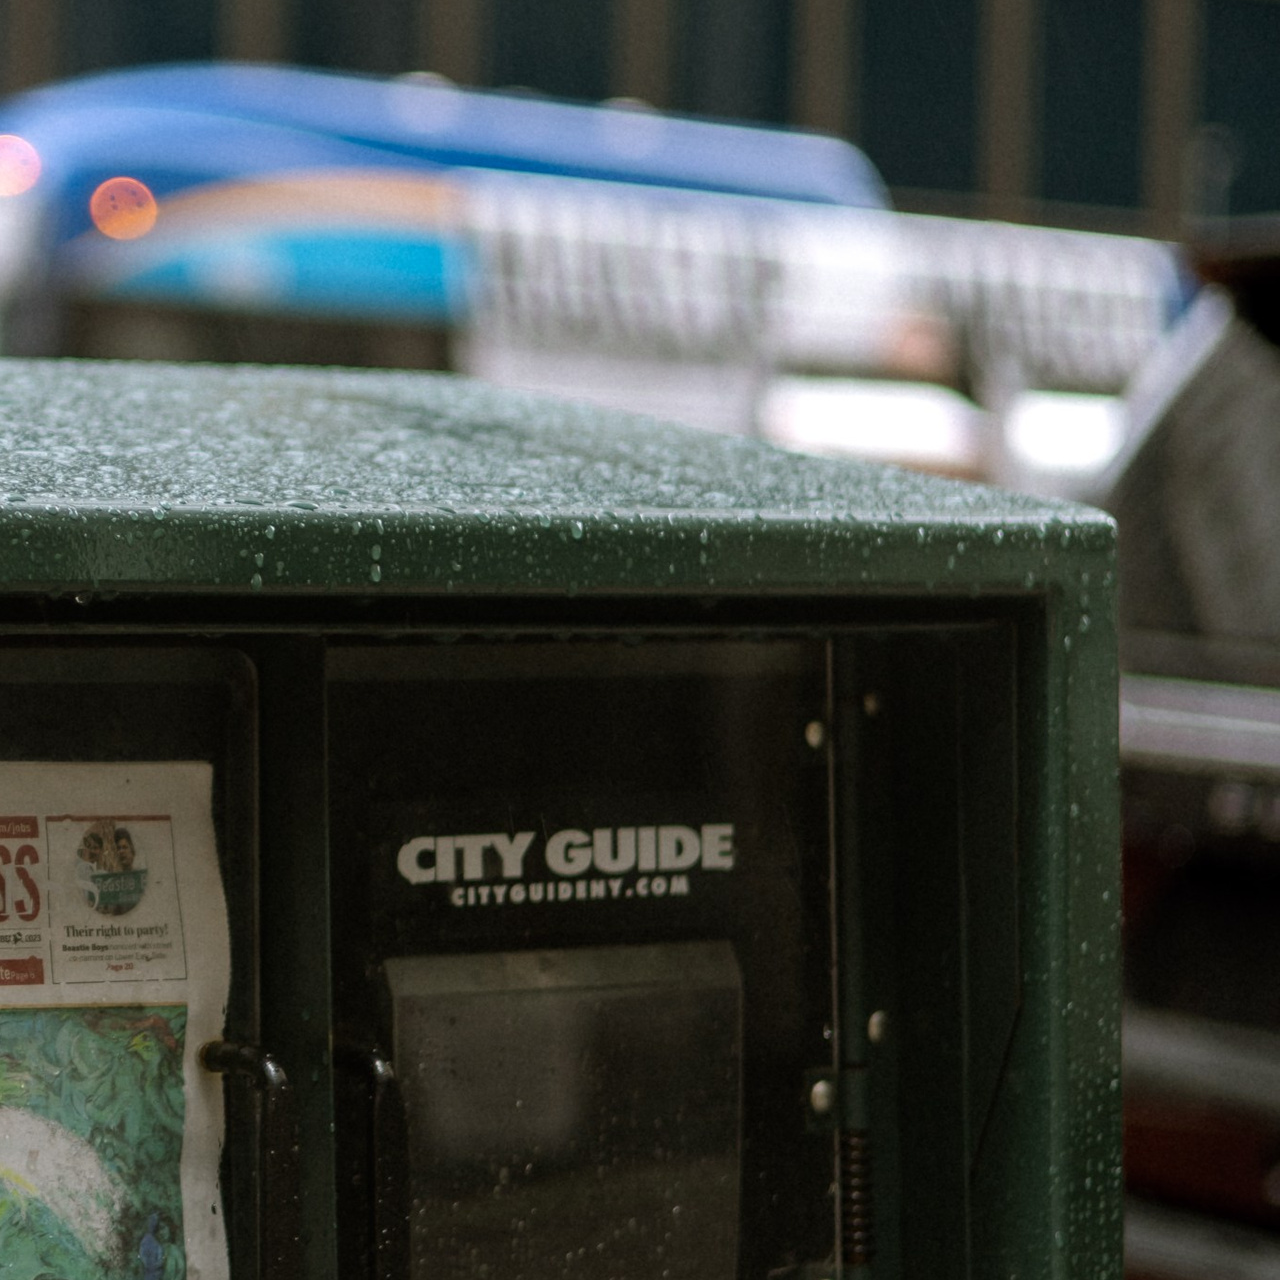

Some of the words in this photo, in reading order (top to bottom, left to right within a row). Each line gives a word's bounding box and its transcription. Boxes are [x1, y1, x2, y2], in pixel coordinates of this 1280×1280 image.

[397, 832, 537, 885] CITY
[544, 823, 735, 878] GUIDE
[451, 874, 690, 908] CITYGUIDENY.COM
[64, 925, 94, 938] Their
[96, 924, 121, 939] right
[124, 926, 135, 936] to
[136, 924, 169, 938] party!
[62, 943, 90, 952] Beastie
[91, 943, 109, 953] Boys
